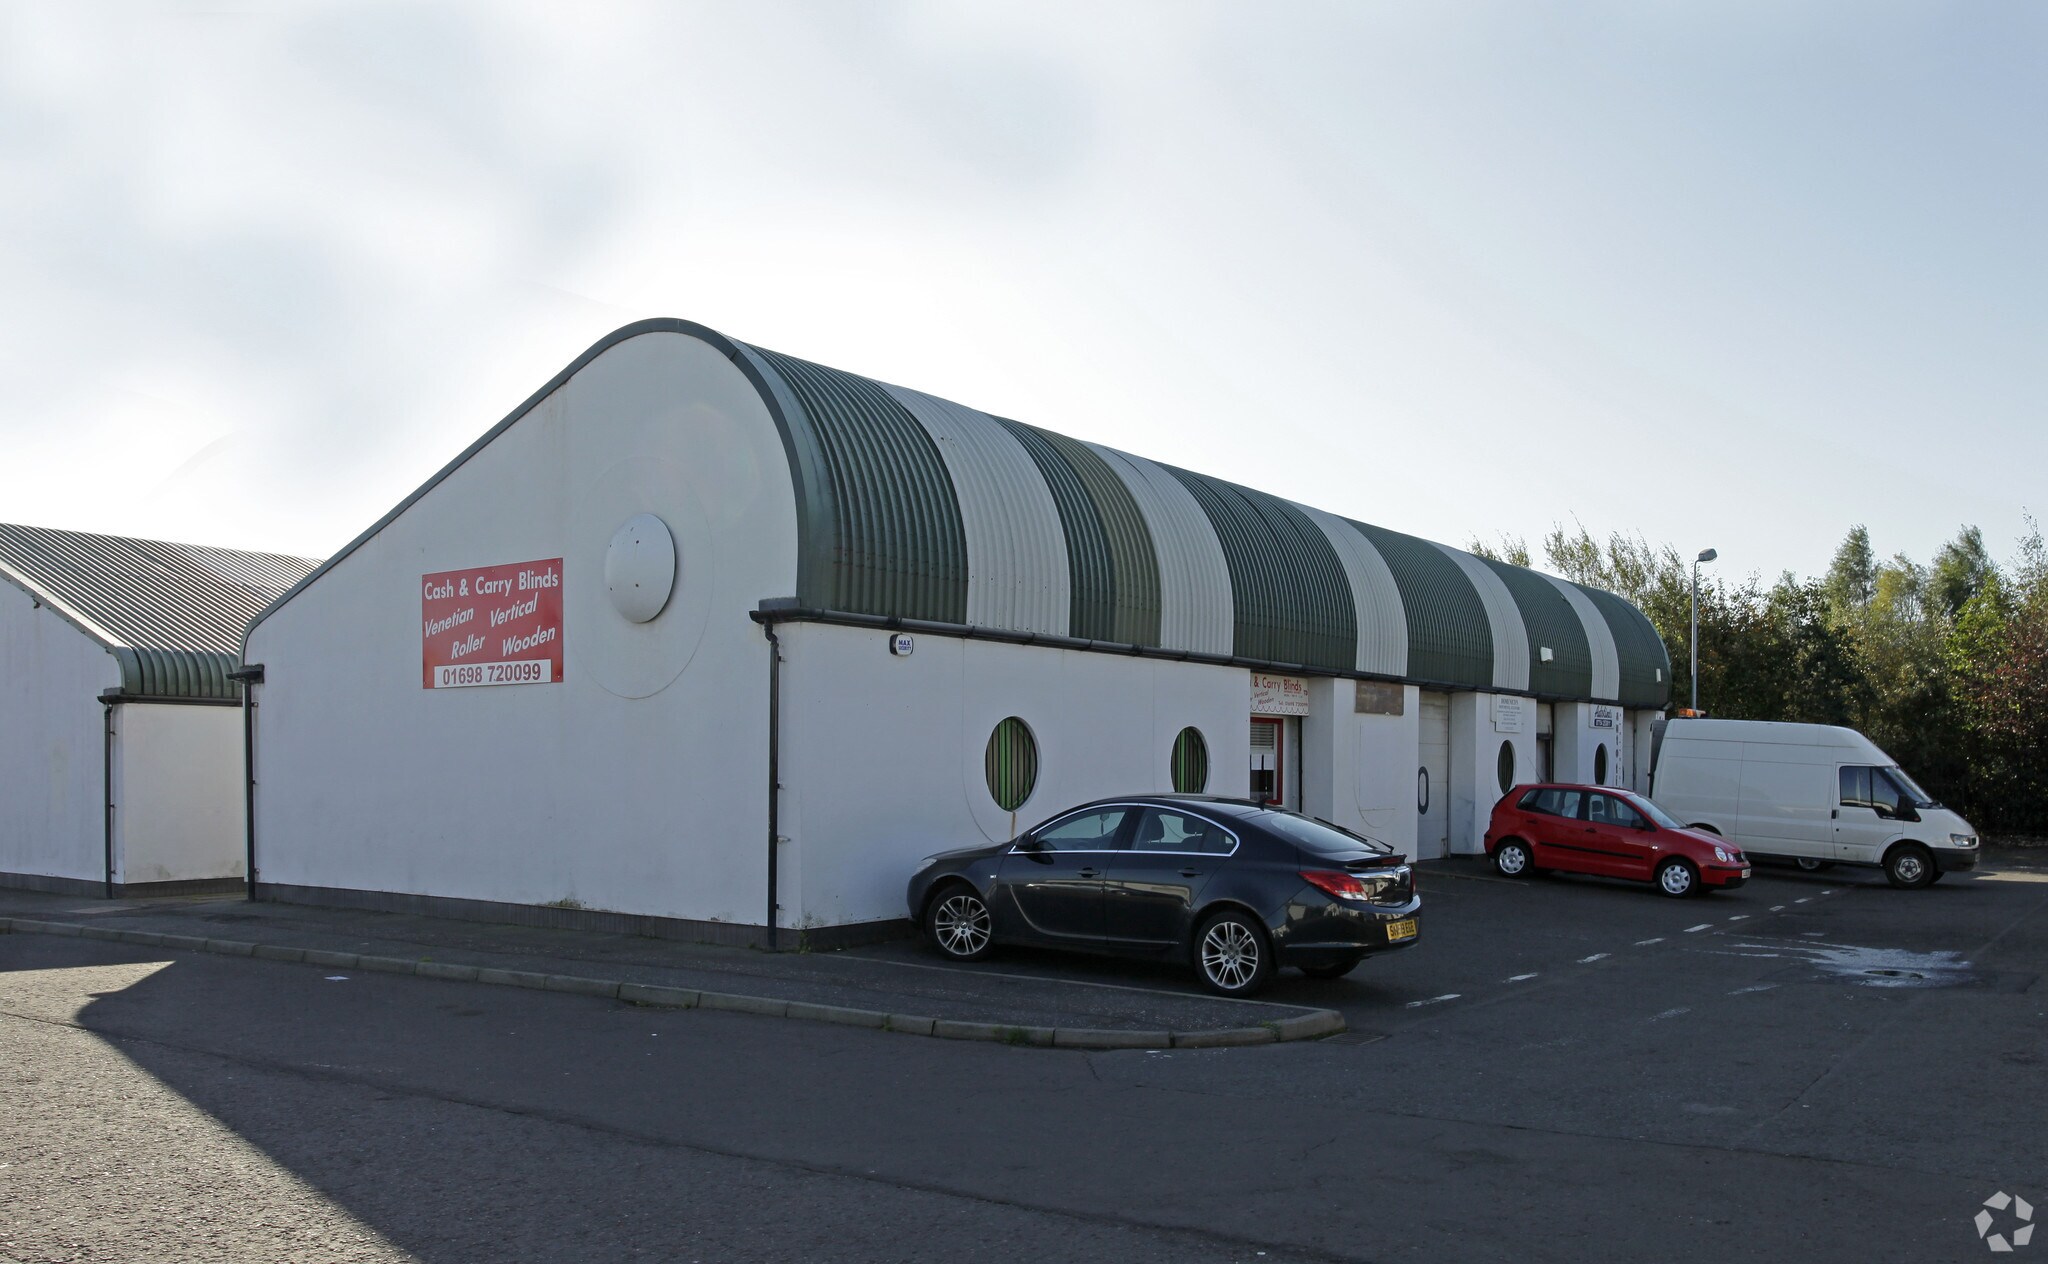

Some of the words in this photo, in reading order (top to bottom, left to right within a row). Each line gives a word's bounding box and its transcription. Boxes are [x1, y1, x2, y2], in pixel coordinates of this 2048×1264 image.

[424, 579, 454, 600] Cash
[459, 578, 469, 597] &
[475, 576, 513, 597] Carry
[518, 567, 559, 591] Blinds
[424, 607, 474, 638] Venetian
[490, 592, 539, 628] Vertical
[451, 634, 486, 660] Roller
[502, 625, 556, 657] Wooden
[443, 666, 483, 685] 01698
[487, 663, 541, 682] 720099
[1262, 676, 1281, 692] Carry
[1283, 678, 1302, 691] Blinds
